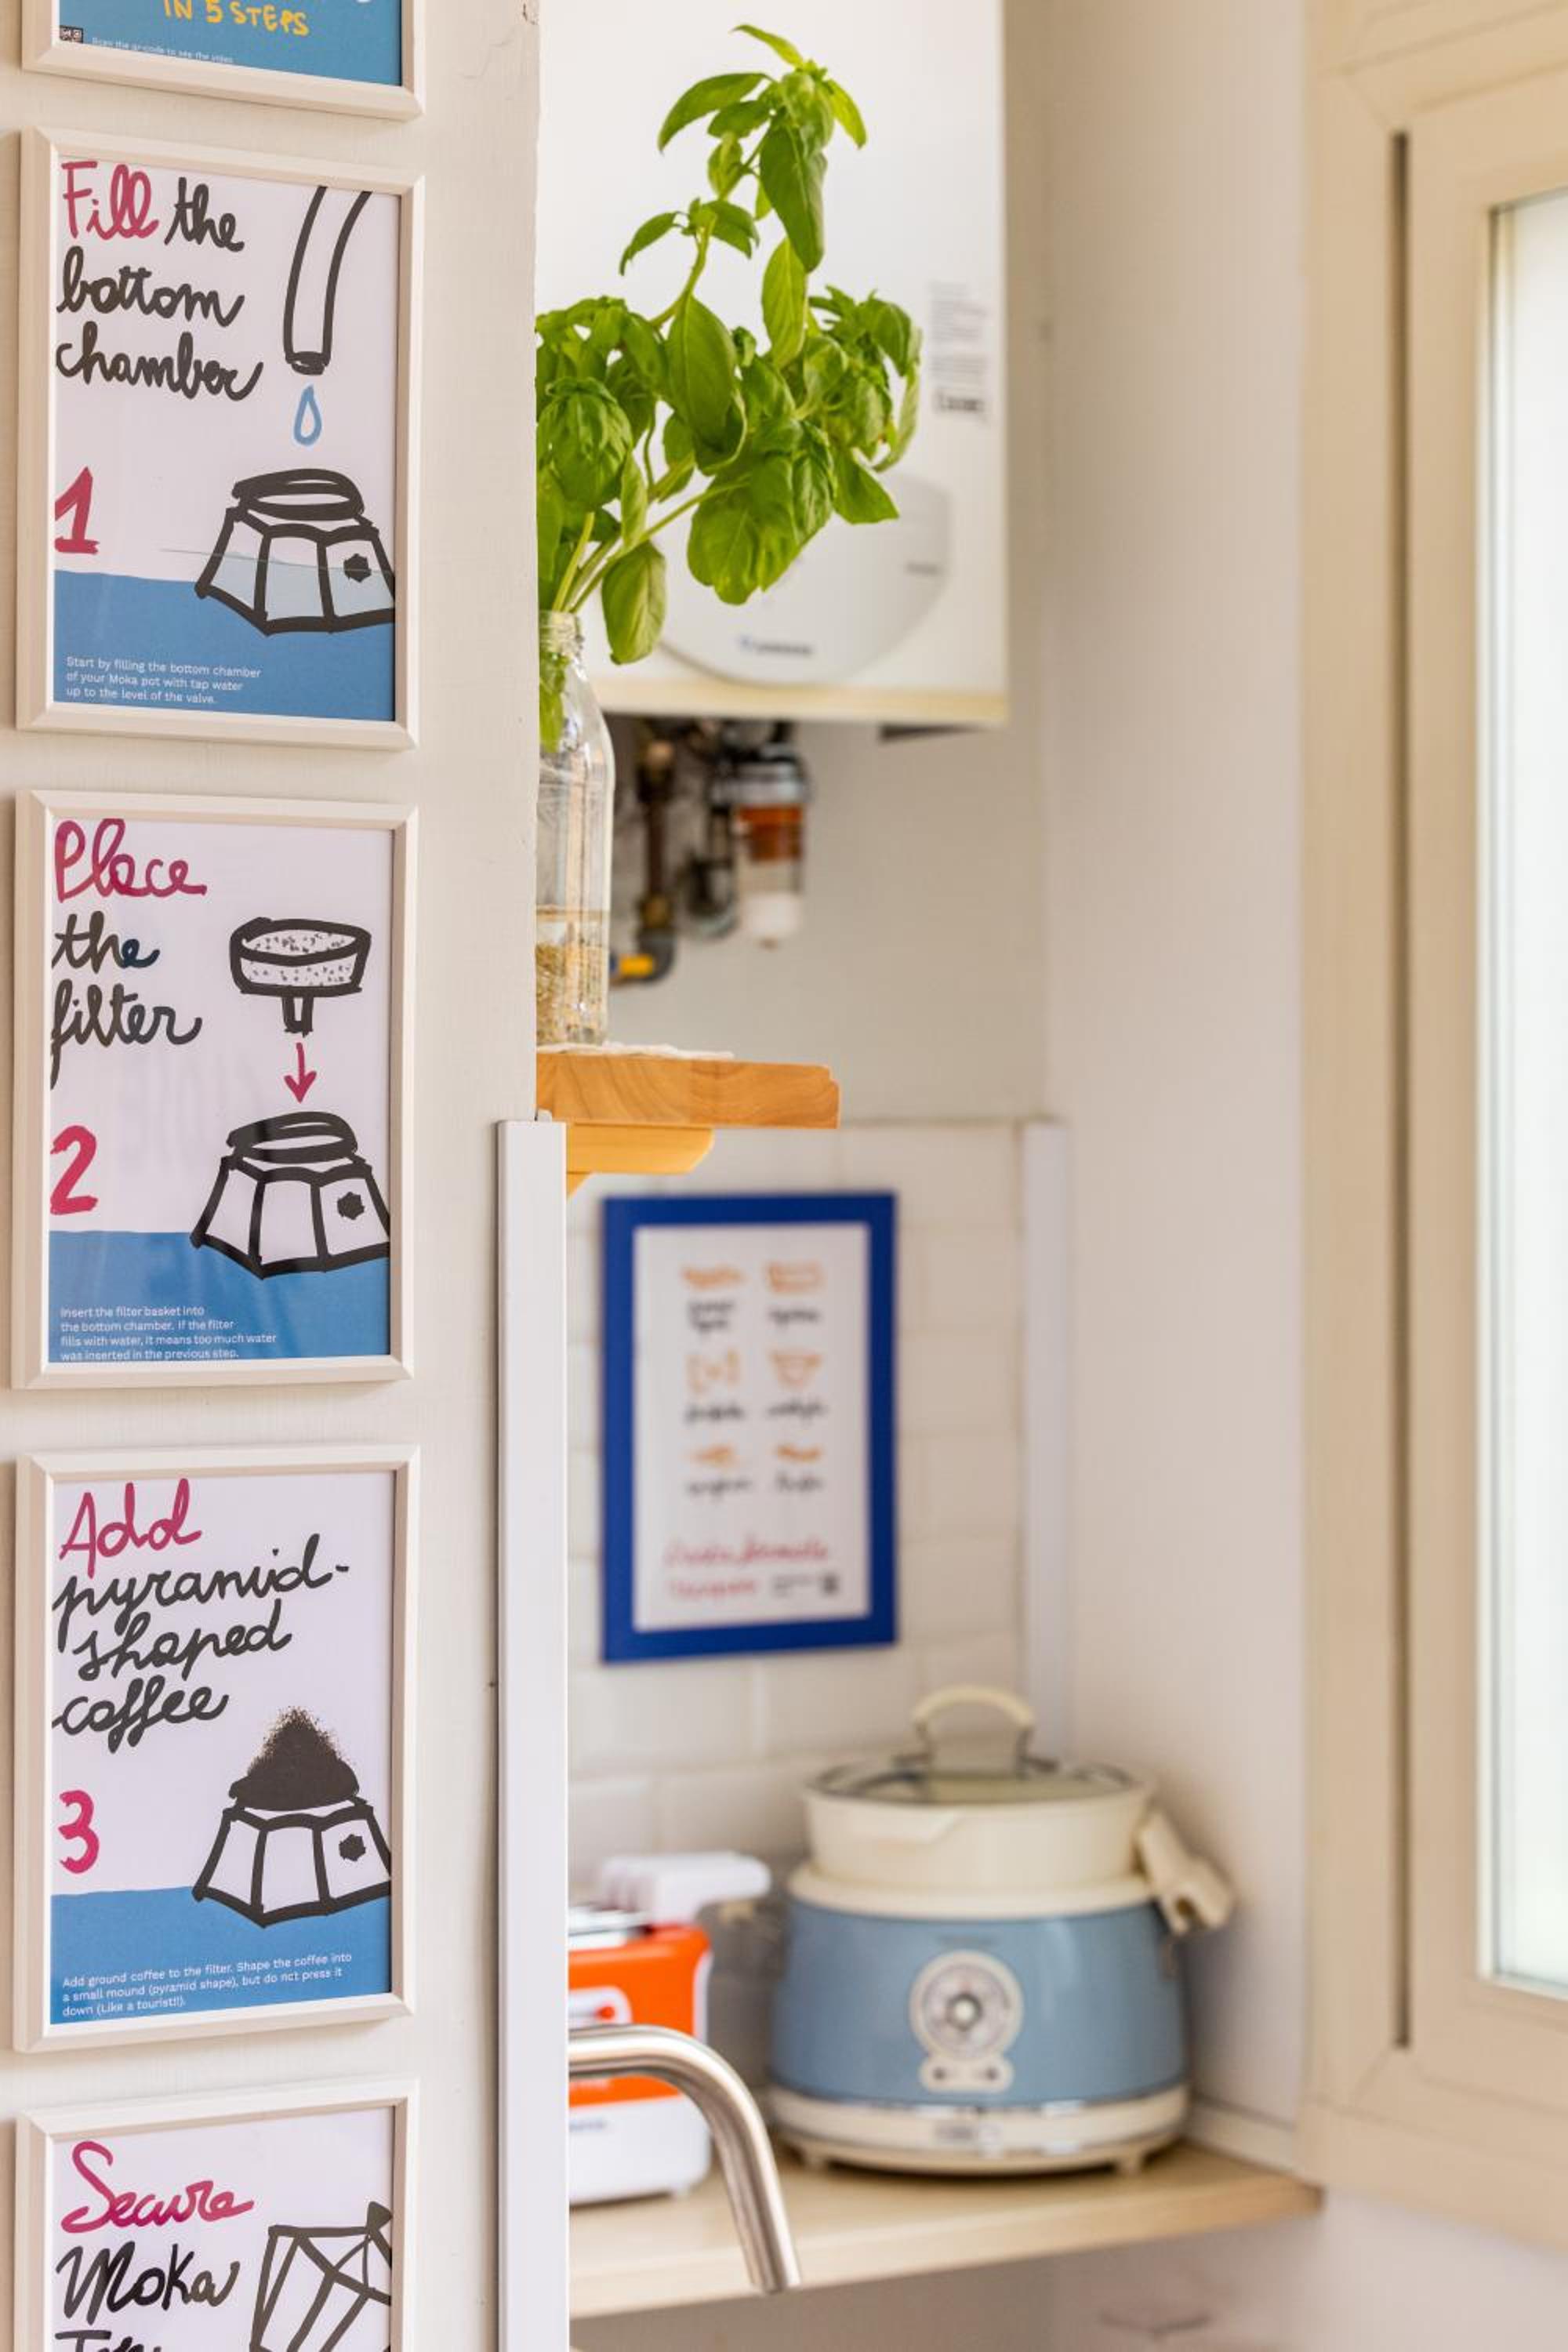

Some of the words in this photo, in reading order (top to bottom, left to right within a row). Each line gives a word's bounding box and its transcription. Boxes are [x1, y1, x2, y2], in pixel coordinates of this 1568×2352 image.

[164, 0, 193, 21] IN
[205, 0, 223, 23] 5
[230, 2, 309, 36] STEPS
[61, 161, 160, 240] Fill
[164, 176, 245, 252] the
[56, 245, 245, 328] bottom
[56, 321, 263, 401] chamber
[54, 466, 100, 555] 1
[66, 671, 78, 682] of
[81, 673, 105, 684] your
[109, 673, 138, 685] Moka
[141, 677, 161, 688] pot
[162, 677, 188, 688] with
[190, 679, 209, 691] tap
[212, 681, 243, 691] water
[66, 688, 81, 699] up
[84, 688, 96, 698] to
[100, 688, 118, 699] the
[122, 687, 147, 701] level
[150, 690, 162, 701] of
[165, 691, 183, 702] the
[67, 656, 94, 668] Start
[98, 658, 111, 672] by
[114, 659, 145, 673] filling
[148, 661, 166, 672] the
[170, 663, 210, 675] bottom
[212, 666, 262, 678] chamber
[55, 818, 207, 902] Place
[51, 911, 160, 974] the
[49, 978, 202, 1090] filter
[49, 1125, 98, 1214] 2
[61, 1306, 94, 1318] Insert
[96, 1307, 114, 1318] the
[116, 1305, 142, 1318] filter
[144, 1305, 182, 1317] basket
[183, 1305, 205, 1316] into
[61, 1321, 79, 1332] the
[82, 1321, 122, 1332] bottom
[178, 1320, 186, 1330] If
[188, 1319, 206, 1330] the
[208, 1319, 234, 1330] filter
[61, 1335, 81, 1347] fills
[84, 1336, 108, 1346] with
[145, 1336, 154, 1345] it
[155, 1336, 192, 1345] means
[194, 1334, 212, 1345] too
[214, 1333, 245, 1345] much
[245, 1333, 277, 1344] water
[61, 1352, 82, 1362] was
[85, 1350, 130, 1361] inserted
[132, 1349, 142, 1360] in
[144, 1348, 162, 1360] the
[164, 1348, 210, 1359] previous
[59, 1478, 201, 1578] Add
[52, 1534, 350, 1653] pyramid-
[72, 1599, 292, 1681] shaped
[51, 1674, 229, 1754] coffee
[57, 1790, 100, 1874] 3
[63, 1976, 85, 1987] Add
[89, 1973, 127, 1987] ground
[131, 1969, 165, 1981] coffee
[169, 1968, 181, 1977] to
[183, 1966, 201, 1976] the
[237, 1961, 270, 1973] Shape
[274, 1958, 291, 1969] the
[294, 1955, 328, 1967] coffee
[330, 1952, 352, 1964] into
[63, 1993, 71, 2002] a
[73, 1988, 103, 2002] small
[106, 1985, 146, 1998] mound
[148, 1980, 197, 1996] (pyramid
[241, 1974, 260, 1986] but
[263, 1973, 278, 1984] do
[281, 1971, 299, 1983] not
[303, 1968, 330, 1982] press
[334, 1967, 342, 1977] it
[63, 2005, 93, 2016] down
[126, 2003, 135, 2012] a
[61, 2140, 254, 2233] Secure
[56, 2241, 240, 2325] Moka
